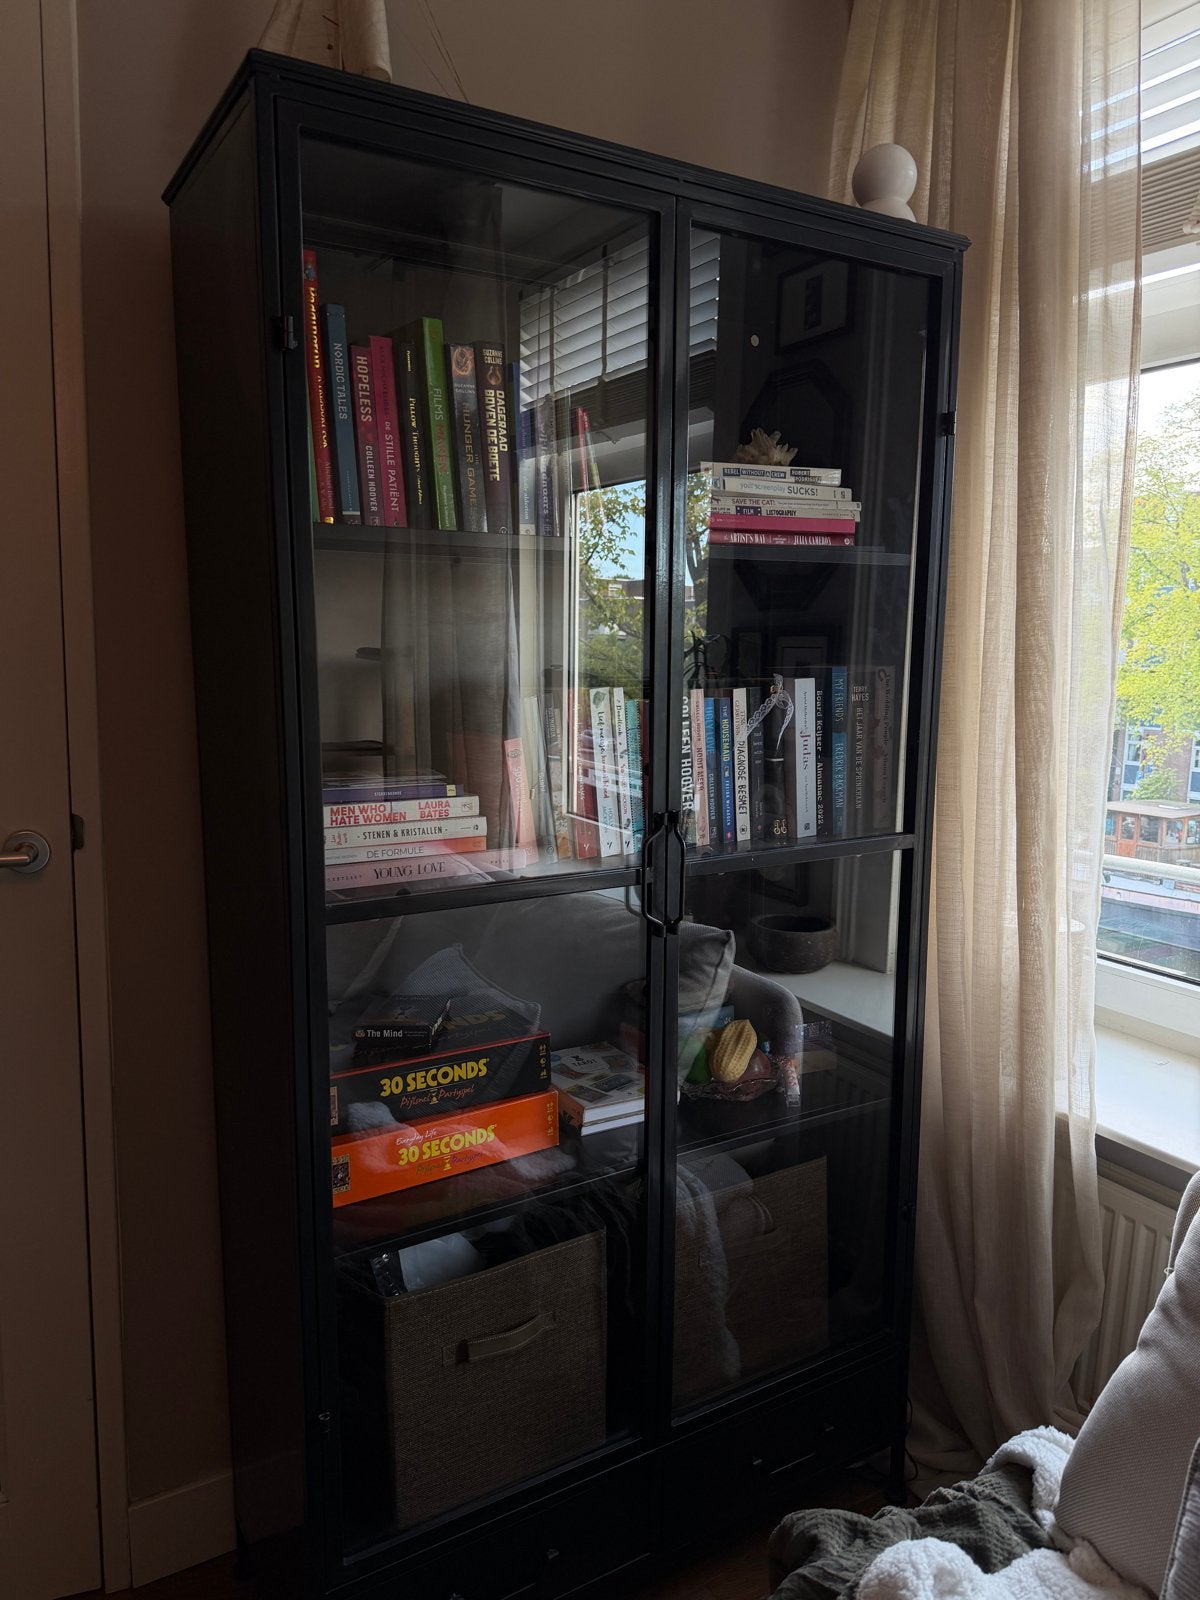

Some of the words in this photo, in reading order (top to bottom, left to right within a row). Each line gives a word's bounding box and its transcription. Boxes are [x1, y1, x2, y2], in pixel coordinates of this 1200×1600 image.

[333, 343, 345, 383] NORDIC
[483, 349, 503, 358] SUZANNE
[484, 356, 503, 365] COLLINS
[355, 355, 373, 422] HOPELESS
[337, 384, 348, 421] TALES
[433, 388, 444, 421] FILMS
[485, 389, 497, 427] BOVEN
[384, 421, 391, 431] DE
[463, 402, 474, 463] HUNGER
[496, 389, 508, 452] DAGERAAD
[435, 424, 447, 472] MAKEN
[487, 428, 498, 444] DE
[365, 445, 375, 479] COLLEEN
[385, 434, 395, 466] STILLE
[488, 445, 500, 481] BOETE
[724, 468, 740, 476] REBEL
[741, 469, 765, 477] WITHOUT
[368, 481, 377, 512] HOOVER
[388, 469, 400, 512] PATIËNT
[740, 482, 754, 490] your
[754, 483, 786, 493] screenplay
[787, 487, 818, 497] SUCKS!
[793, 536, 808, 545] JULIA
[808, 536, 832, 545] CAMERON
[836, 678, 844, 690] MY
[835, 692, 844, 722] FRIENDS
[851, 692, 870, 702] HAYES
[597, 711, 605, 727] Lief
[705, 706, 714, 731] UGLY
[855, 707, 863, 720] HET
[706, 732, 714, 753] LOVE
[722, 719, 730, 762] HOUSEMAID
[855, 722, 863, 739] JAAR
[800, 730, 811, 771] Judas
[835, 742, 845, 771] FREDRIK
[855, 741, 863, 754] VAN
[736, 741, 746, 780] DIAGNOSE
[855, 756, 863, 765] DE
[681, 759, 695, 811] HOOVER
[816, 762, 824, 801] Almanac
[835, 774, 845, 808] BACKMAN
[855, 766, 863, 809] SPRINKHAAN
[330, 806, 357, 817] MEN
[357, 804, 387, 815] WHO
[418, 800, 451, 809] LAURA
[738, 784, 747, 815] BESMET
[330, 815, 360, 826] HATE
[363, 811, 407, 824] WOMEN
[419, 809, 450, 819] BATES
[816, 803, 824, 825] 2022
[363, 830, 391, 840] STENEN
[393, 829, 399, 838] &
[401, 826, 443, 837] KRISTALLEN
[366, 850, 380, 859] DE
[381, 846, 424, 857] FORMULE
[373, 864, 413, 880] YOUNG
[417, 861, 446, 875] LOVE
[366, 1029, 381, 1038] The
[383, 1029, 403, 1038] Mind
[380, 1077, 404, 1098] 30
[407, 1058, 488, 1092] SECONDS
[396, 1133, 424, 1146] Everyday
[424, 1128, 437, 1138] Life
[398, 1148, 420, 1166] 30
[422, 1125, 496, 1159] SECONDS
